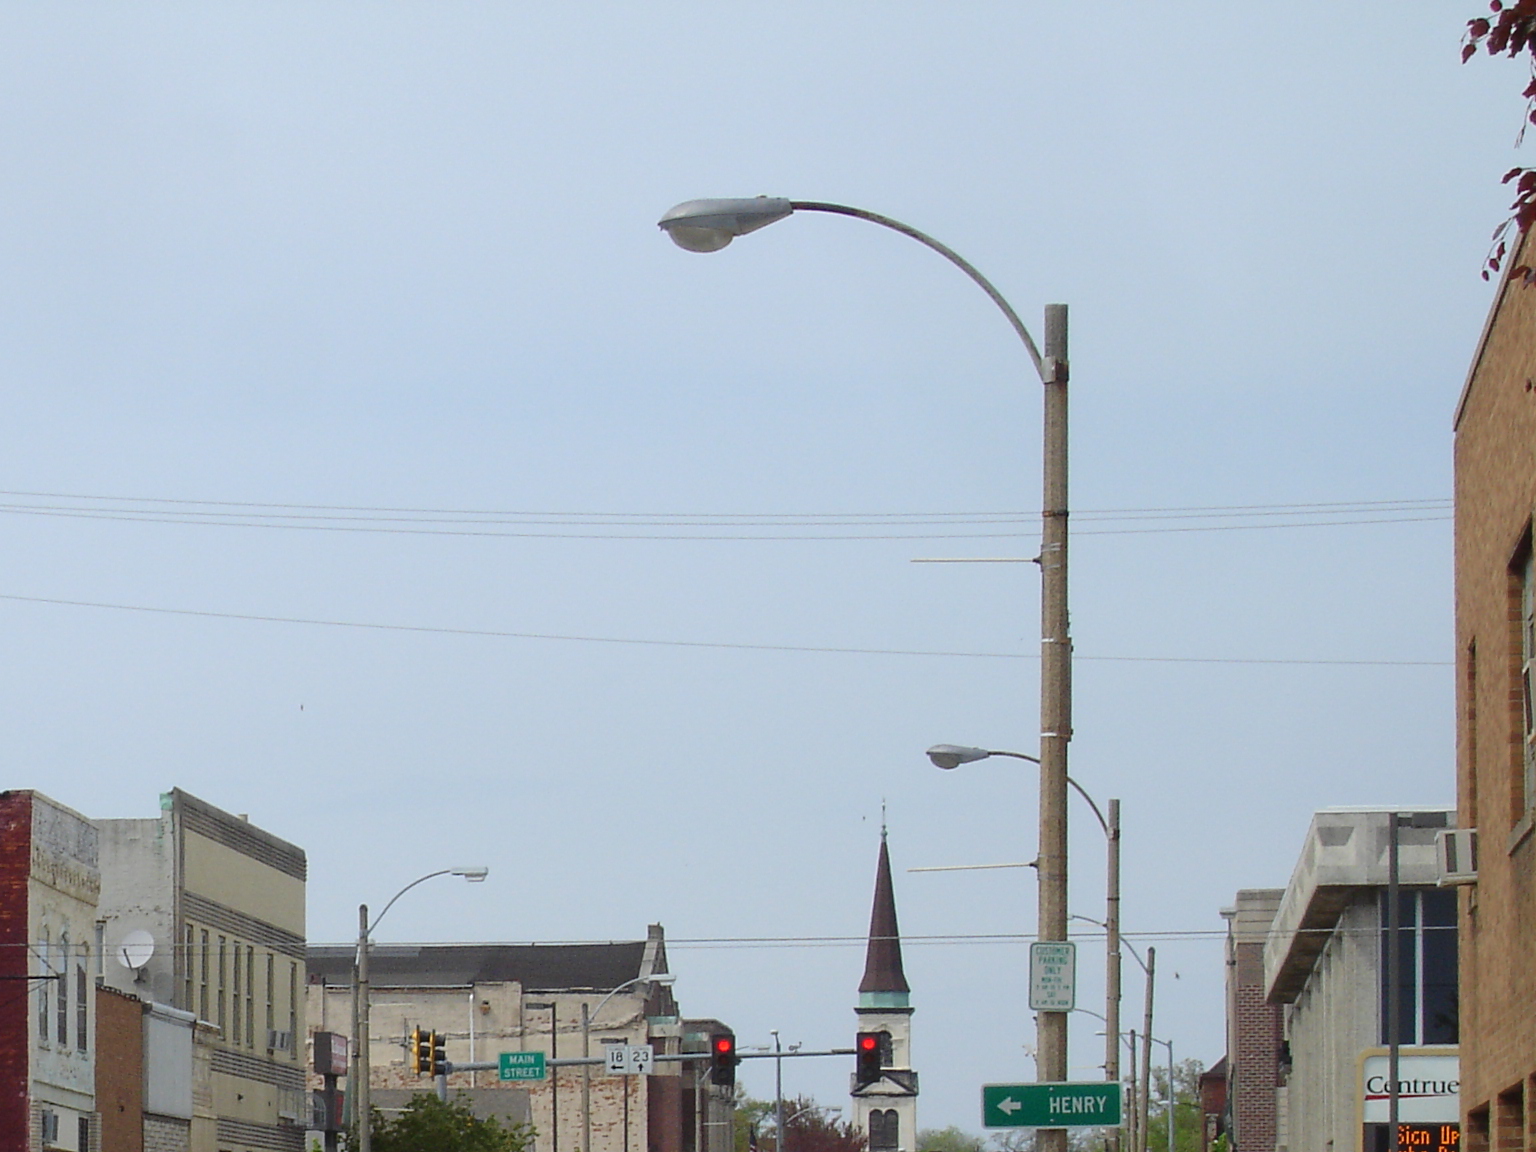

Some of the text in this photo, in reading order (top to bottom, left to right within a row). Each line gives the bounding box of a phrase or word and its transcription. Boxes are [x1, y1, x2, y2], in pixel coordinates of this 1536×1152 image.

[1038, 956, 1068, 965] PARKING
[1044, 966, 1061, 974] ONLY
[509, 1055, 535, 1064] MAIN
[611, 1052, 624, 1062] 18
[632, 1051, 649, 1062] 23
[504, 1067, 541, 1078] STREET
[1049, 1096, 1107, 1114] HENRY
